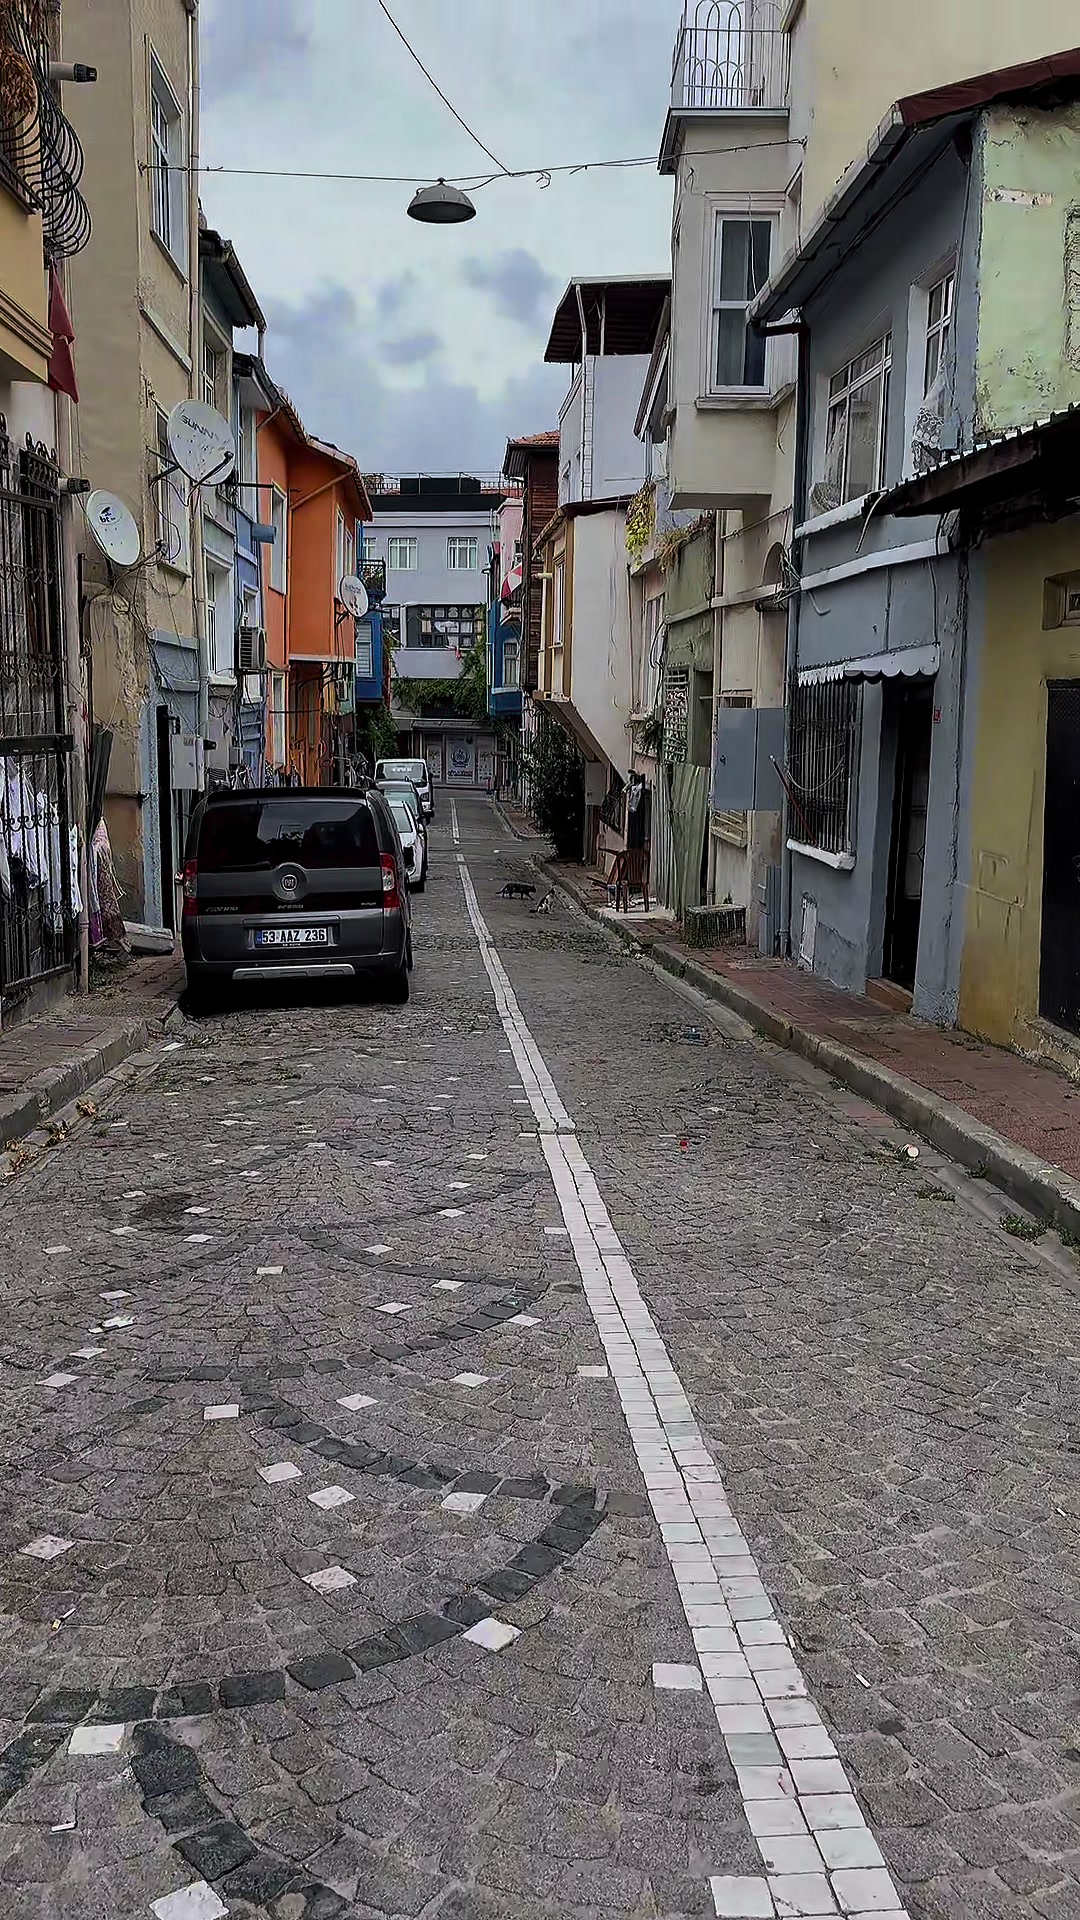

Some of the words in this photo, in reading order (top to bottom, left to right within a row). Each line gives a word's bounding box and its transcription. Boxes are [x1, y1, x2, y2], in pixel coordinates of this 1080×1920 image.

[262, 931, 276, 943] 53
[280, 930, 301, 943] AAZ
[304, 929, 326, 942] 236
